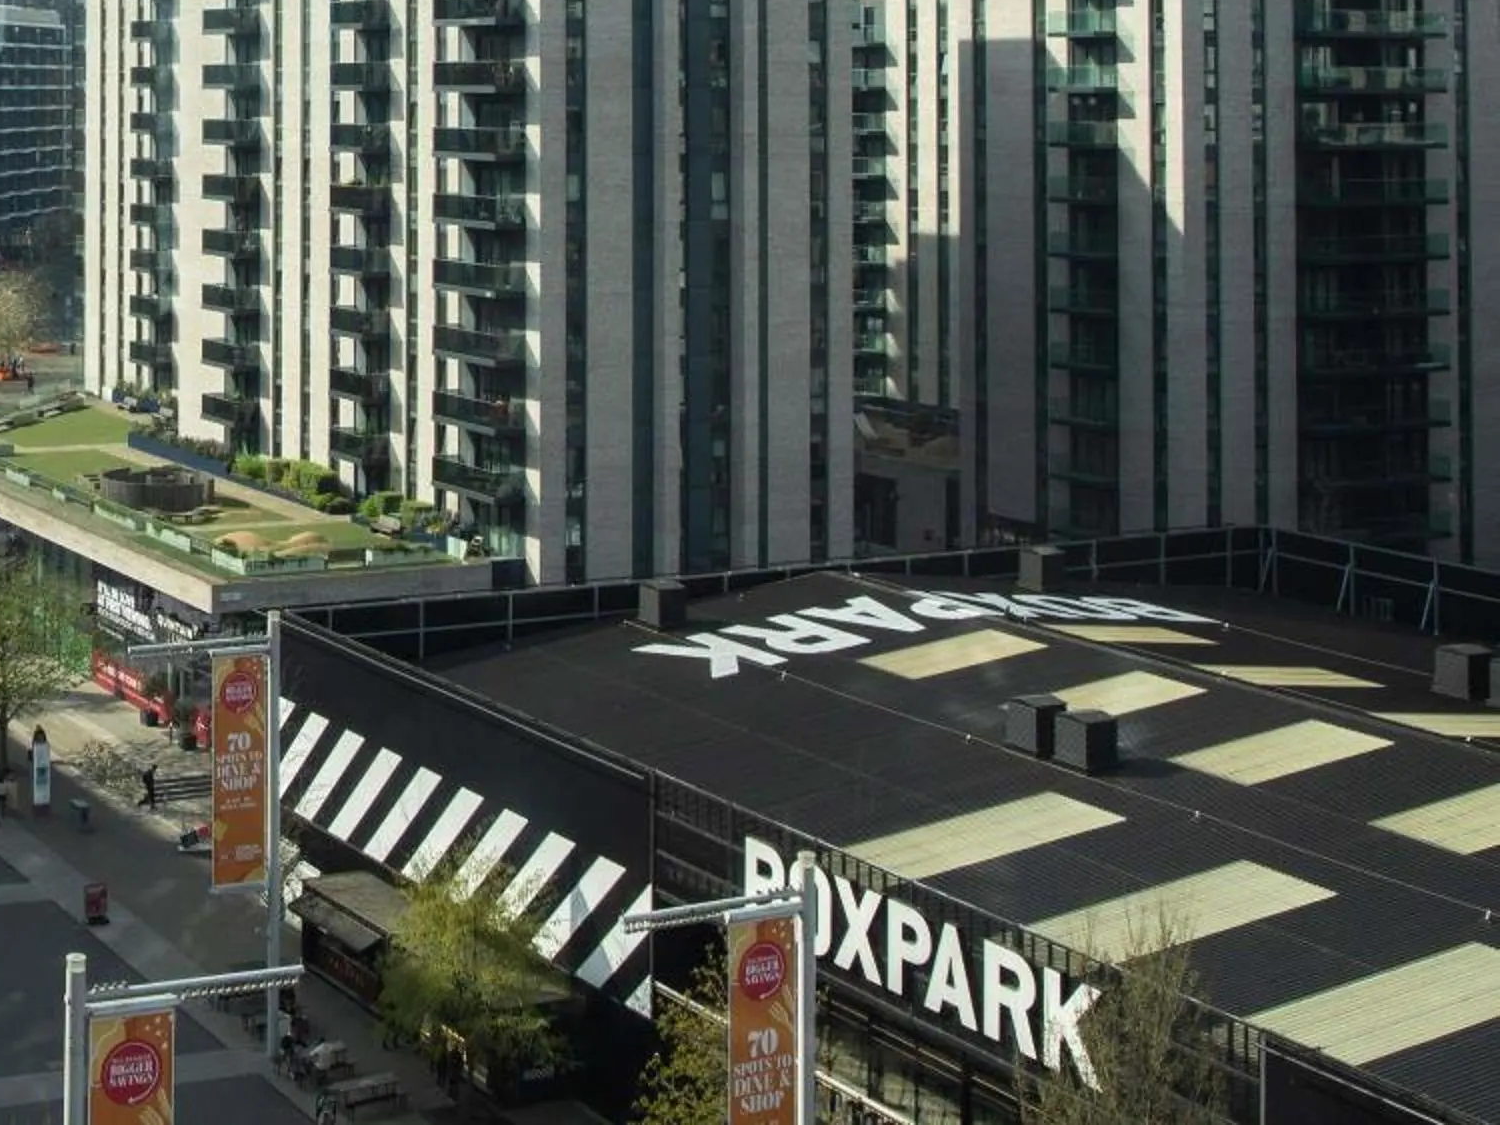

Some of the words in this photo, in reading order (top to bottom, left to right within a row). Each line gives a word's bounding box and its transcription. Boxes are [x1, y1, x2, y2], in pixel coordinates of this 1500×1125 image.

[632, 588, 1219, 679] BOXPARK
[227, 731, 252, 752] 70
[221, 775, 258, 792] SHOP
[747, 1027, 779, 1059] 70
[733, 1058, 773, 1077] SPOTS
[775, 1053, 793, 1070] TO
[734, 1072, 774, 1098] DINE
[779, 1068, 792, 1088] &
[740, 1089, 785, 1116] SHOP
